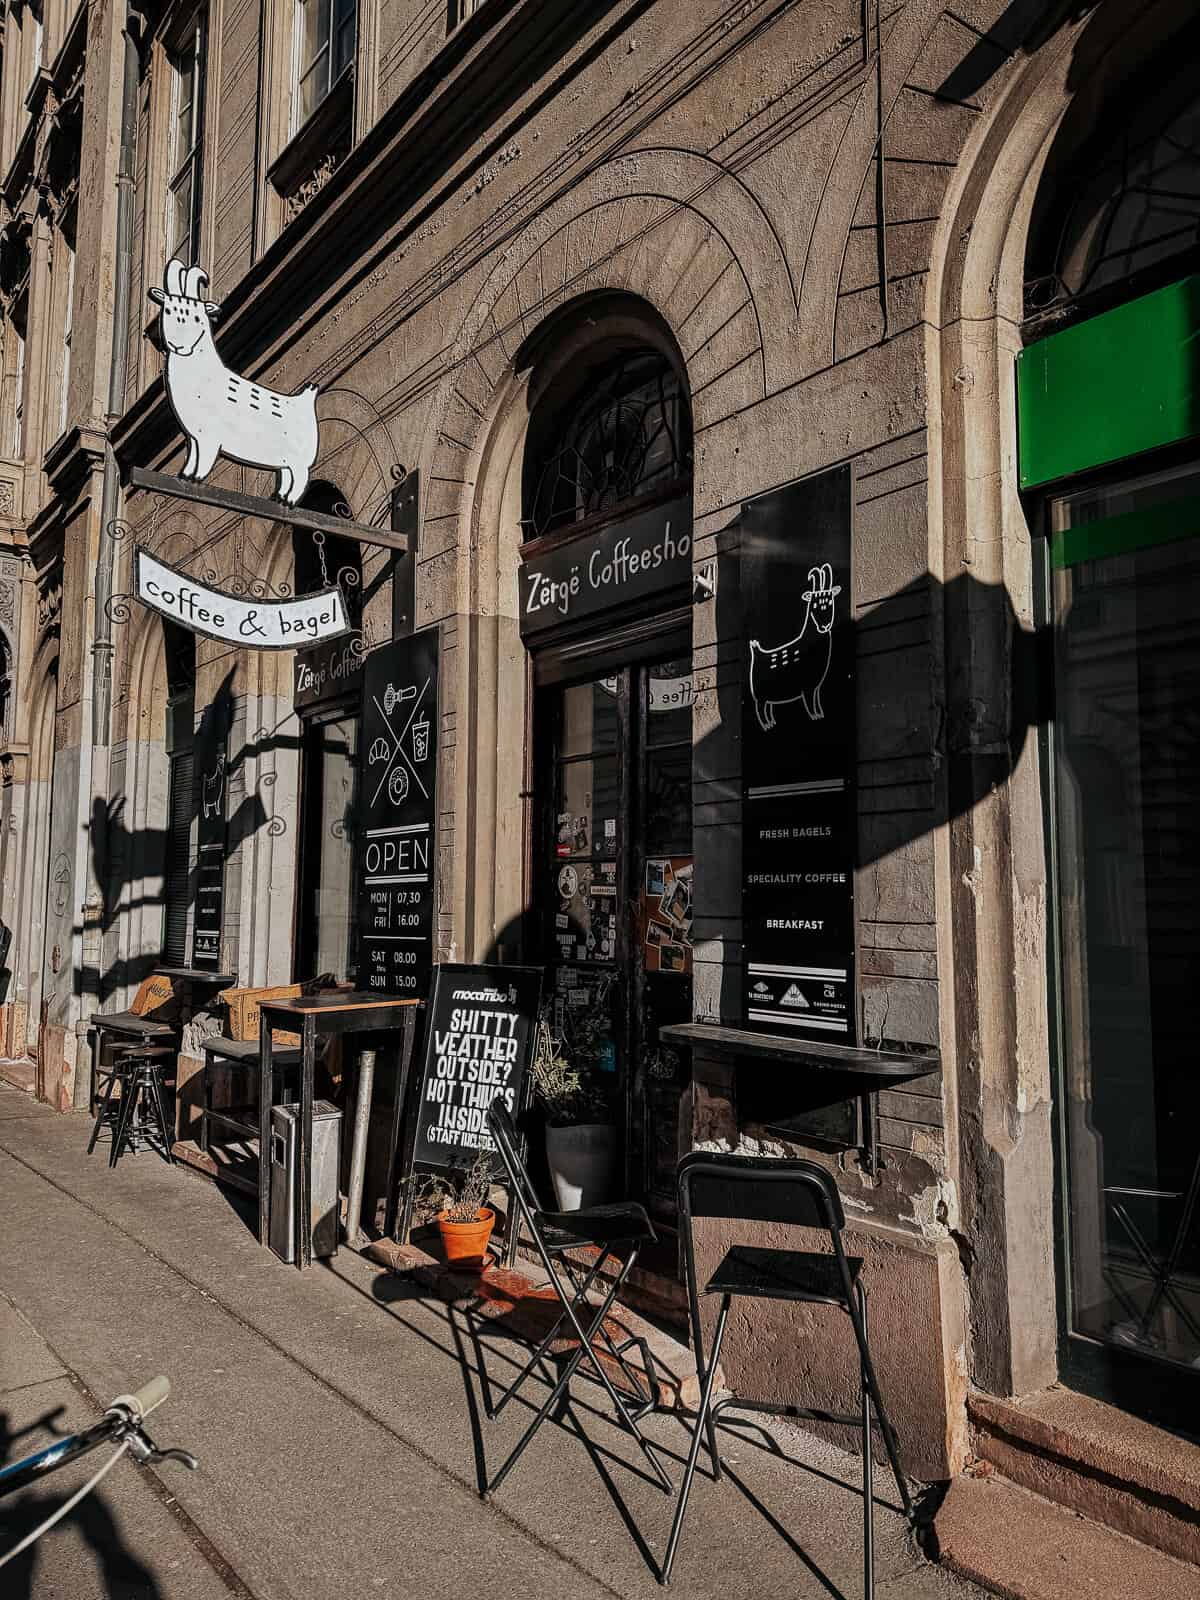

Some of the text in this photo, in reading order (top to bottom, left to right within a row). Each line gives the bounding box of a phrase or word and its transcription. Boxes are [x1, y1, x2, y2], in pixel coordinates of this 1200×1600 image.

[526, 521, 691, 614] Zërgë Coffeesho
[146, 581, 337, 636] coffee & bagel
[759, 827, 832, 839] FRESH BAGELS
[366, 837, 428, 872] OPEN
[747, 873, 847, 883] SPECIALITY COFFEE
[370, 892, 387, 904] MON
[374, 914, 420, 928] FRI 16.00
[766, 919, 824, 930] BREAKFAST
[371, 950, 416, 964] SAT 08.00
[370, 975, 417, 988] SUN 15.00
[449, 1008, 519, 1037] SHITTY
[434, 1030, 518, 1062] WEATHER
[437, 1055, 513, 1086] OUTSIDE?
[426, 1078, 457, 1104] HOT
[426, 1124, 461, 1145] (STAFF
